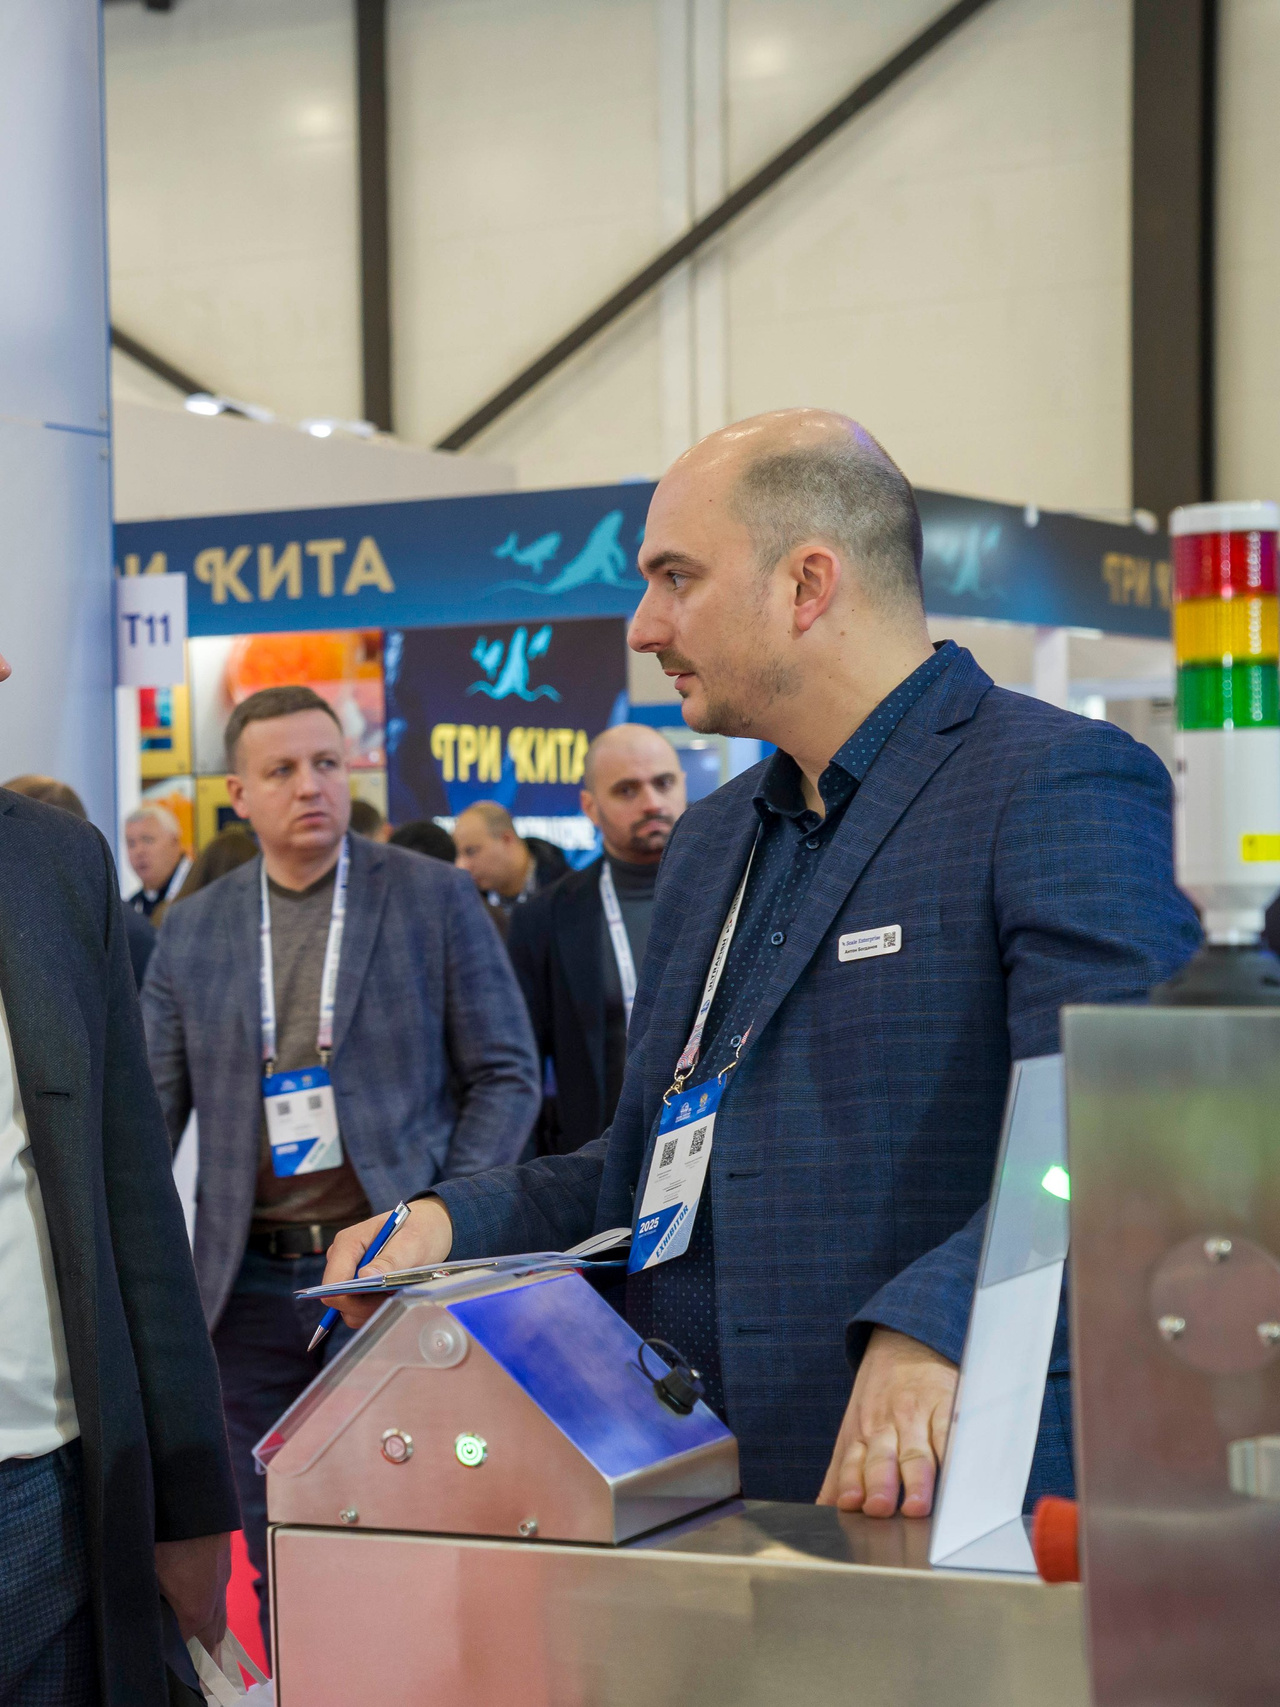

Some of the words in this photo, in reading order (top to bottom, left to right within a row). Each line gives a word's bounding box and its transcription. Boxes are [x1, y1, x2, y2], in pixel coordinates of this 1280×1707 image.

[193, 535, 396, 604] КИТА
[122, 613, 170, 646] T11
[430, 723, 501, 782] ТРИ
[639, 1217, 660, 1234] 2025
[656, 1205, 689, 1258] EXHIBITOR
